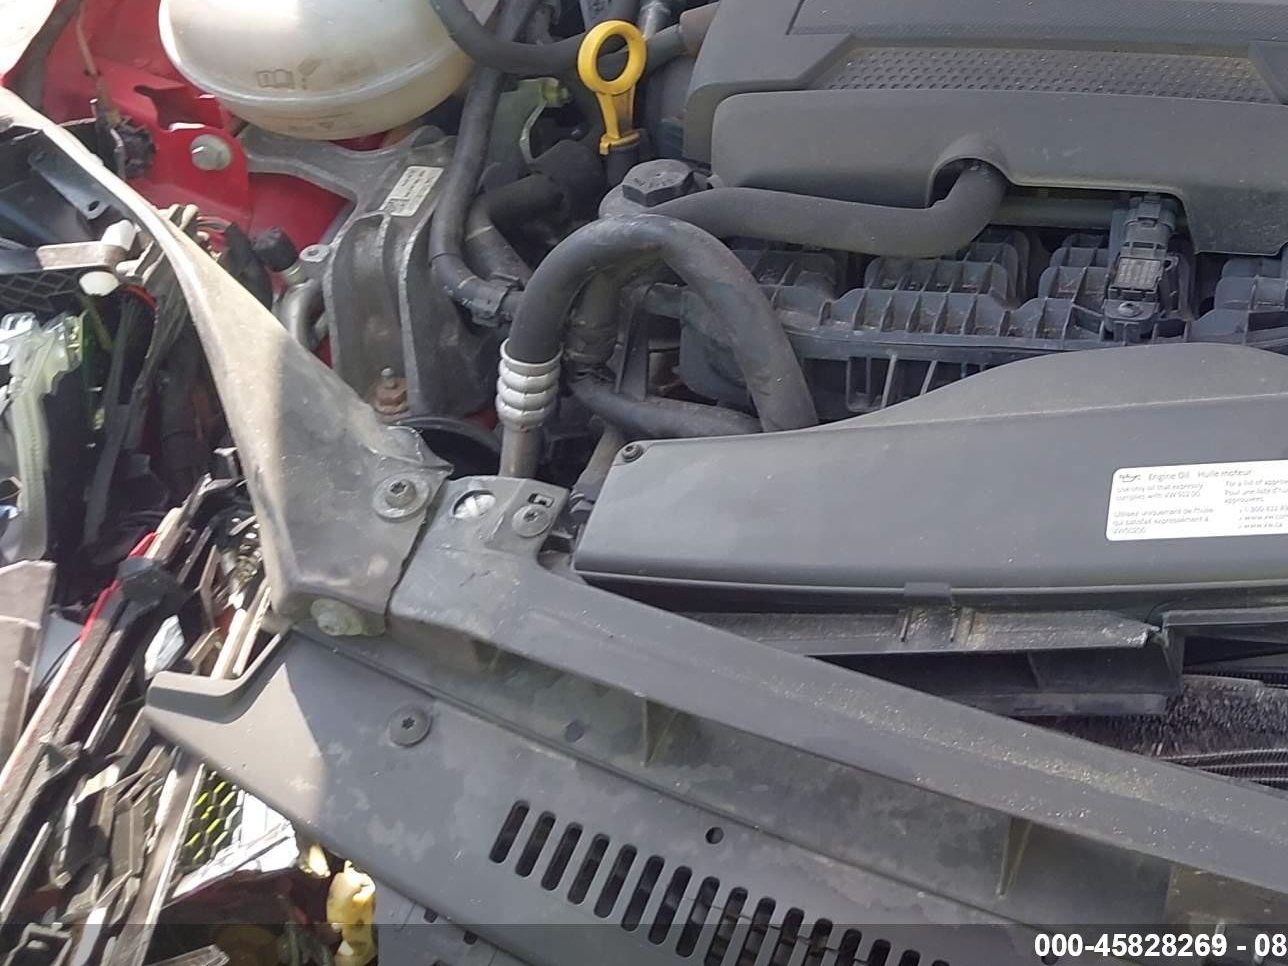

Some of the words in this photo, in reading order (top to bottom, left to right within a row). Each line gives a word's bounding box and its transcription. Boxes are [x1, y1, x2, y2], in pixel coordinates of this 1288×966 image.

[1148, 471, 1176, 482] Engine
[1177, 471, 1189, 479] Oil
[1197, 469, 1219, 478] Huile
[1220, 468, 1251, 476] moteur
